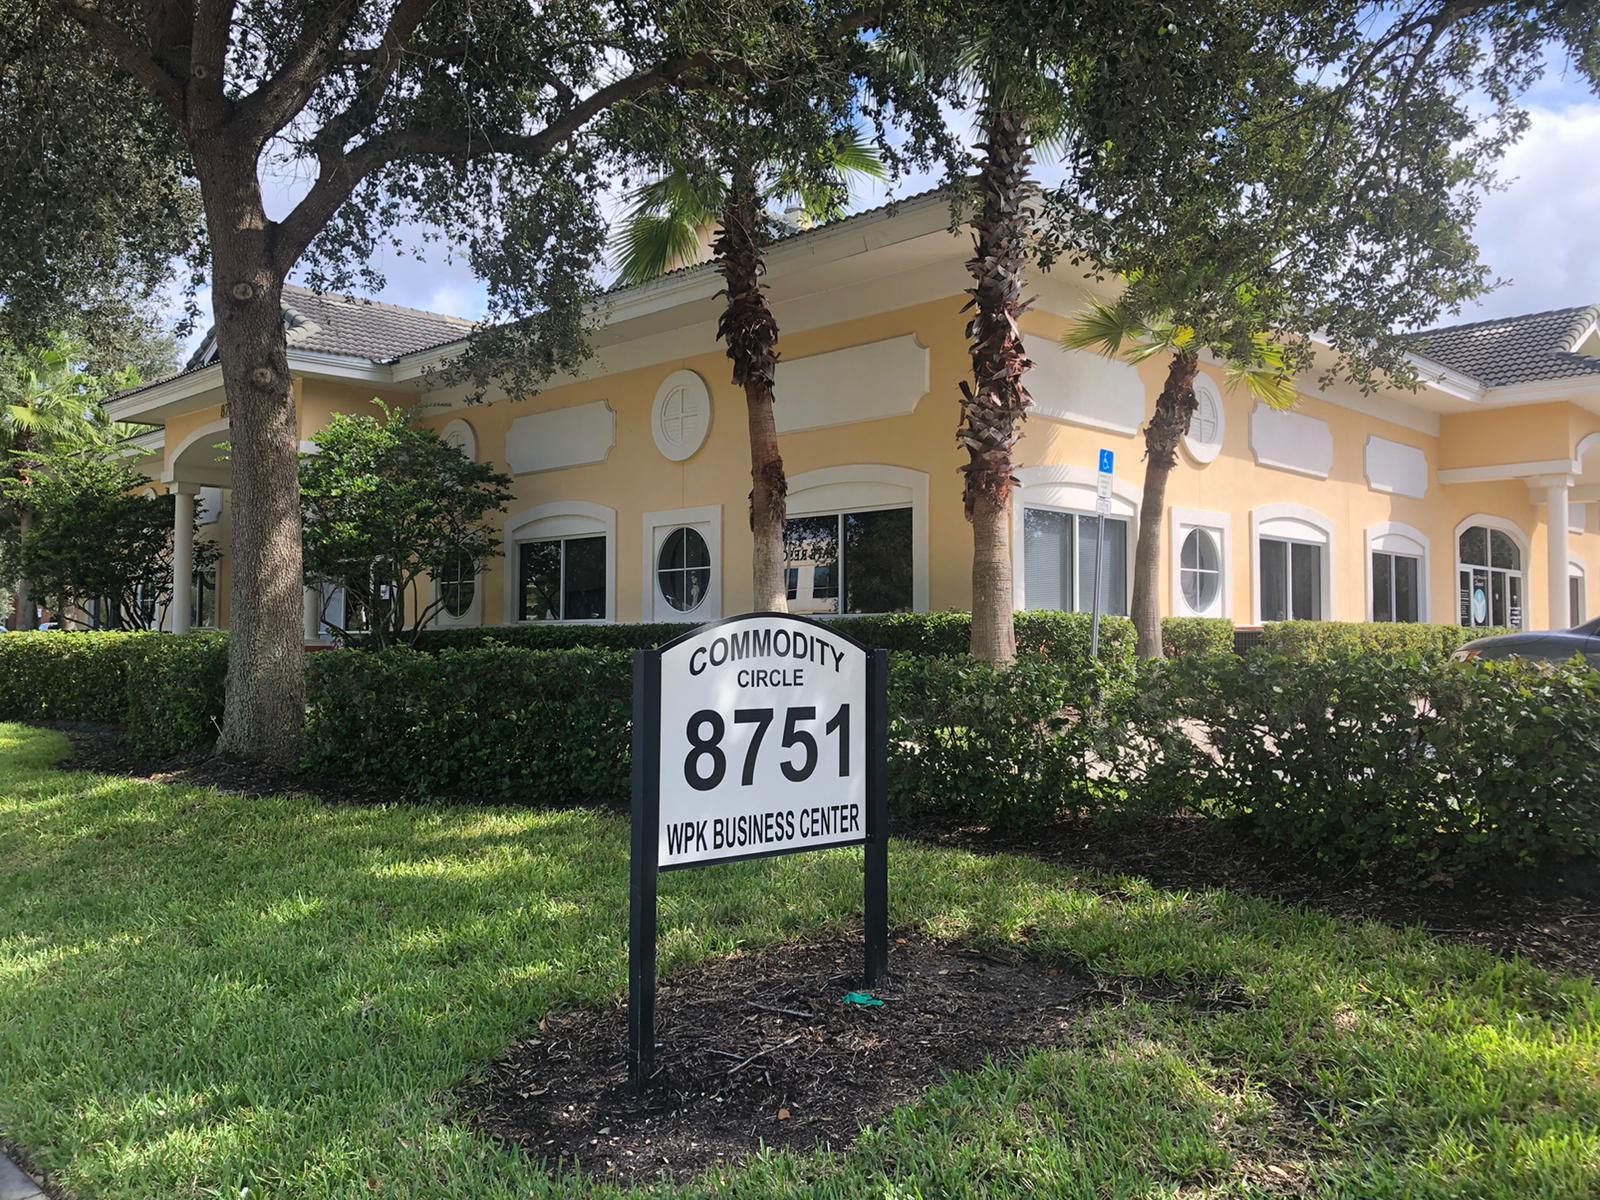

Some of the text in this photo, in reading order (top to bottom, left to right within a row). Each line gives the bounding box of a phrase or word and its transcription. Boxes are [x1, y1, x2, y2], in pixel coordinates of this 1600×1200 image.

[689, 628, 845, 677] COMMODITY
[737, 669, 804, 688] CIRCLE
[684, 703, 851, 792] 8751
[667, 803, 860, 856] WPK BUSINESS CENTER
